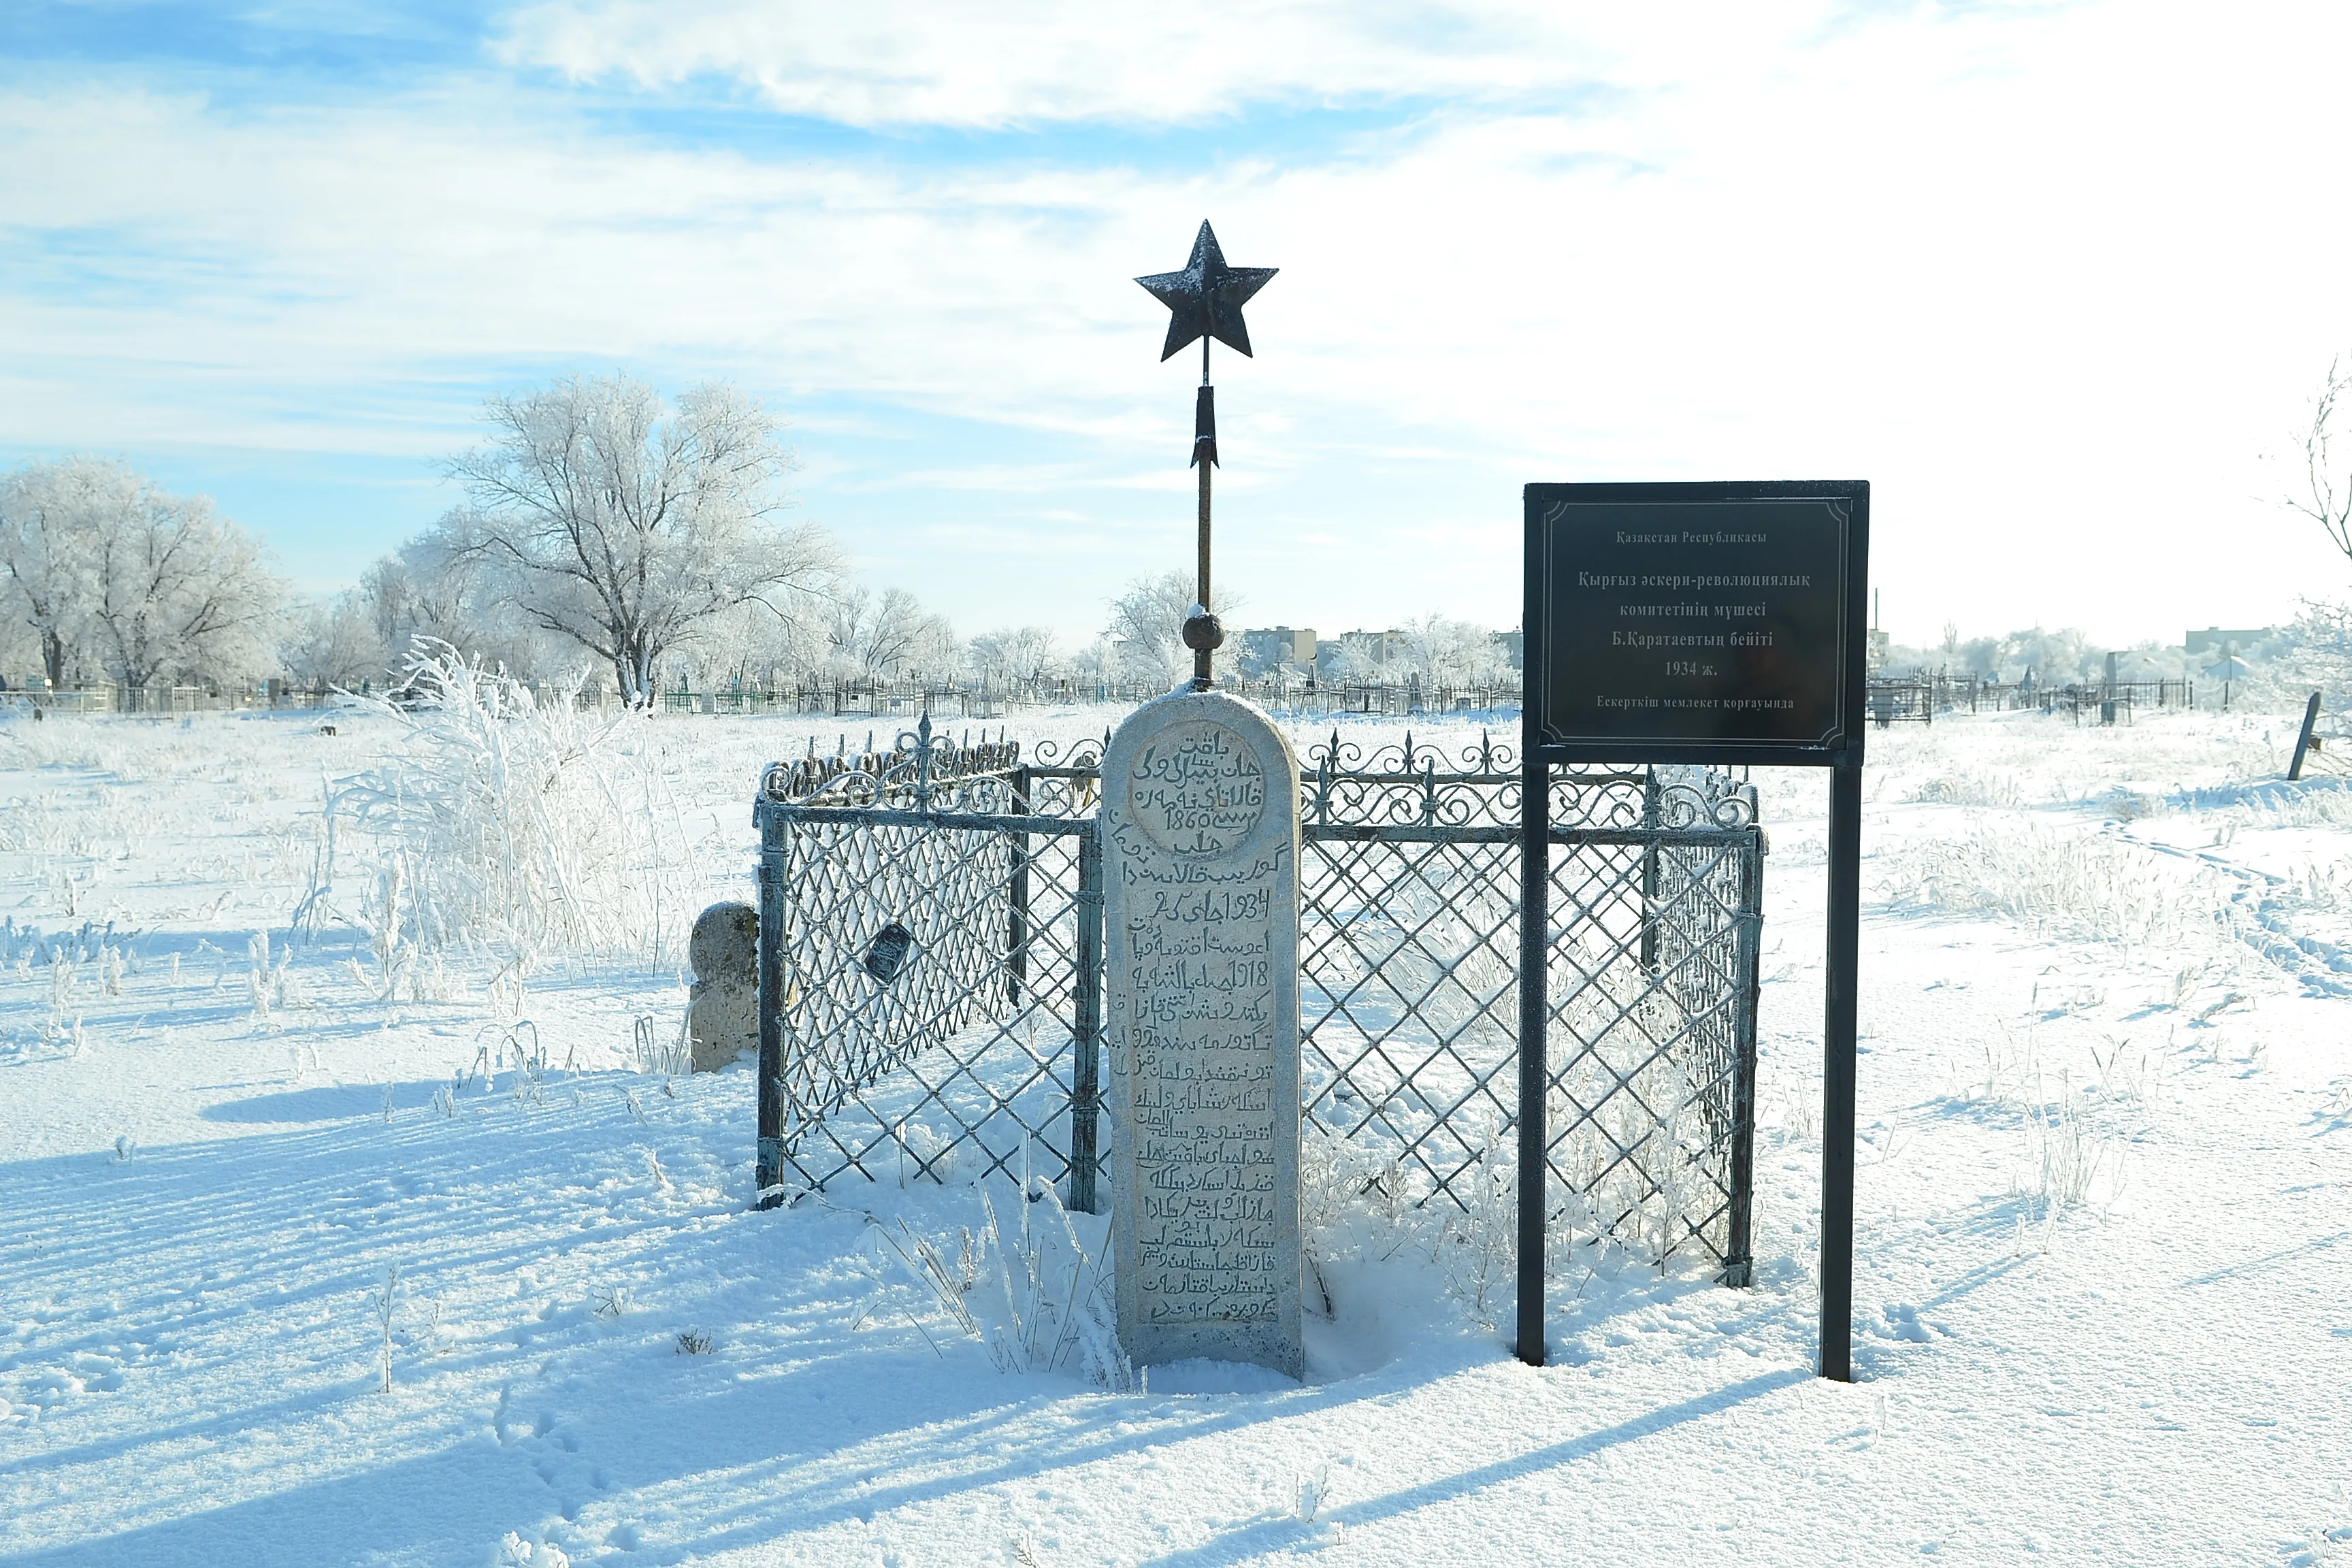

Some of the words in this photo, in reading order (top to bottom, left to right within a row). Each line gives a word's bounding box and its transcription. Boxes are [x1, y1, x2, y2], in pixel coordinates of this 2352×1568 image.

[1616, 531, 1678, 544] Қазақстан
[1682, 531, 1767, 546] Республикасы
[1578, 571, 1637, 591] Қырғыз
[1641, 575, 1811, 591] әскери-революциялық
[1619, 602, 1709, 619] комитетінің
[1714, 601, 1767, 620] мүшесі
[1612, 630, 1725, 651] Б.Қаратаевтың
[1729, 631, 1774, 647] бейіті
[1665, 660, 1697, 676] 1934
[1701, 665, 1718, 676] ж.
[1597, 694, 1659, 711] Ескерткіш
[1663, 698, 1720, 708] мемлекет
[1723, 699, 1795, 712] қорғауында
